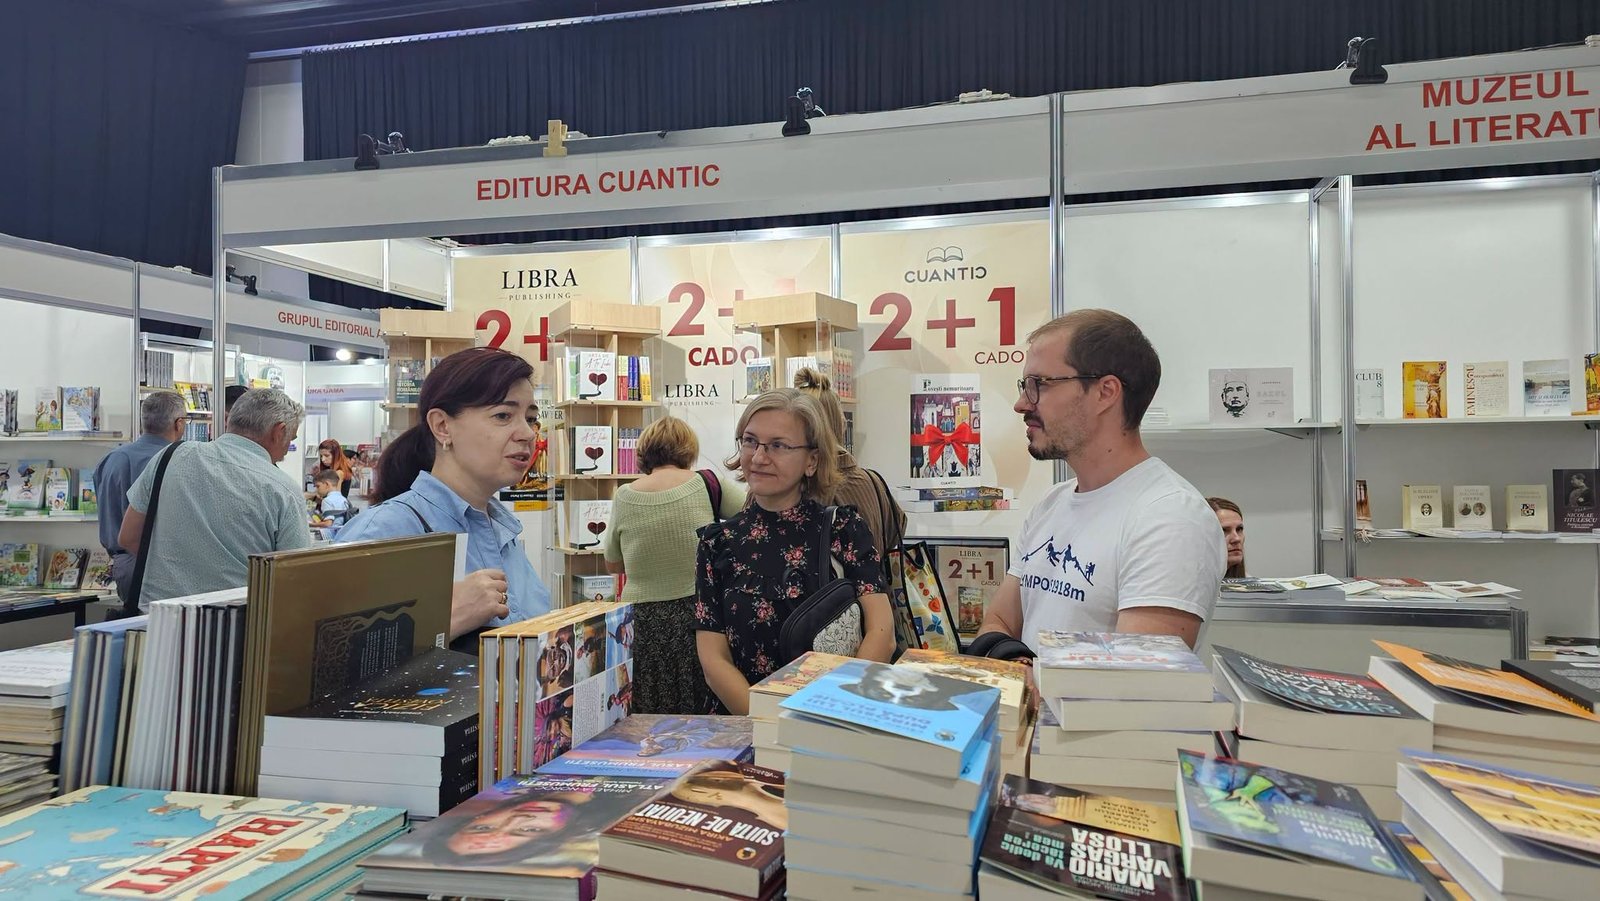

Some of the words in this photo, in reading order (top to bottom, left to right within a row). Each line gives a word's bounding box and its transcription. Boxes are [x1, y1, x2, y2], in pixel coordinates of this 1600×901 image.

[1422, 70, 1589, 108] MUZEUL
[1365, 123, 1416, 150] AL
[1429, 108, 1600, 146] LITERAT
[477, 173, 591, 201] EDITURA
[598, 163, 720, 193] CUANTIC
[501, 267, 578, 290] LIBRA
[508, 291, 571, 301] PUBLISHING
[278, 311, 323, 329] GRUPUL
[325, 319, 375, 338] EDITORIAL
[475, 309, 565, 361] 2+
[688, 345, 760, 367] CADO
[974, 350, 1025, 365] CADO
[664, 383, 719, 398] LIBRA
[603, 782, 665, 790] ATLASUL
[626, 816, 704, 835] MIZUBAYASHI
[634, 803, 703, 826] NEUITAT
[703, 814, 728, 834] DE
[703, 828, 734, 842] AKIRA
[729, 820, 782, 846] SUITA
[1071, 827, 1152, 858] LLOSA
[1070, 841, 1172, 878] VARGAS
[1069, 856, 1155, 891] MARIO
